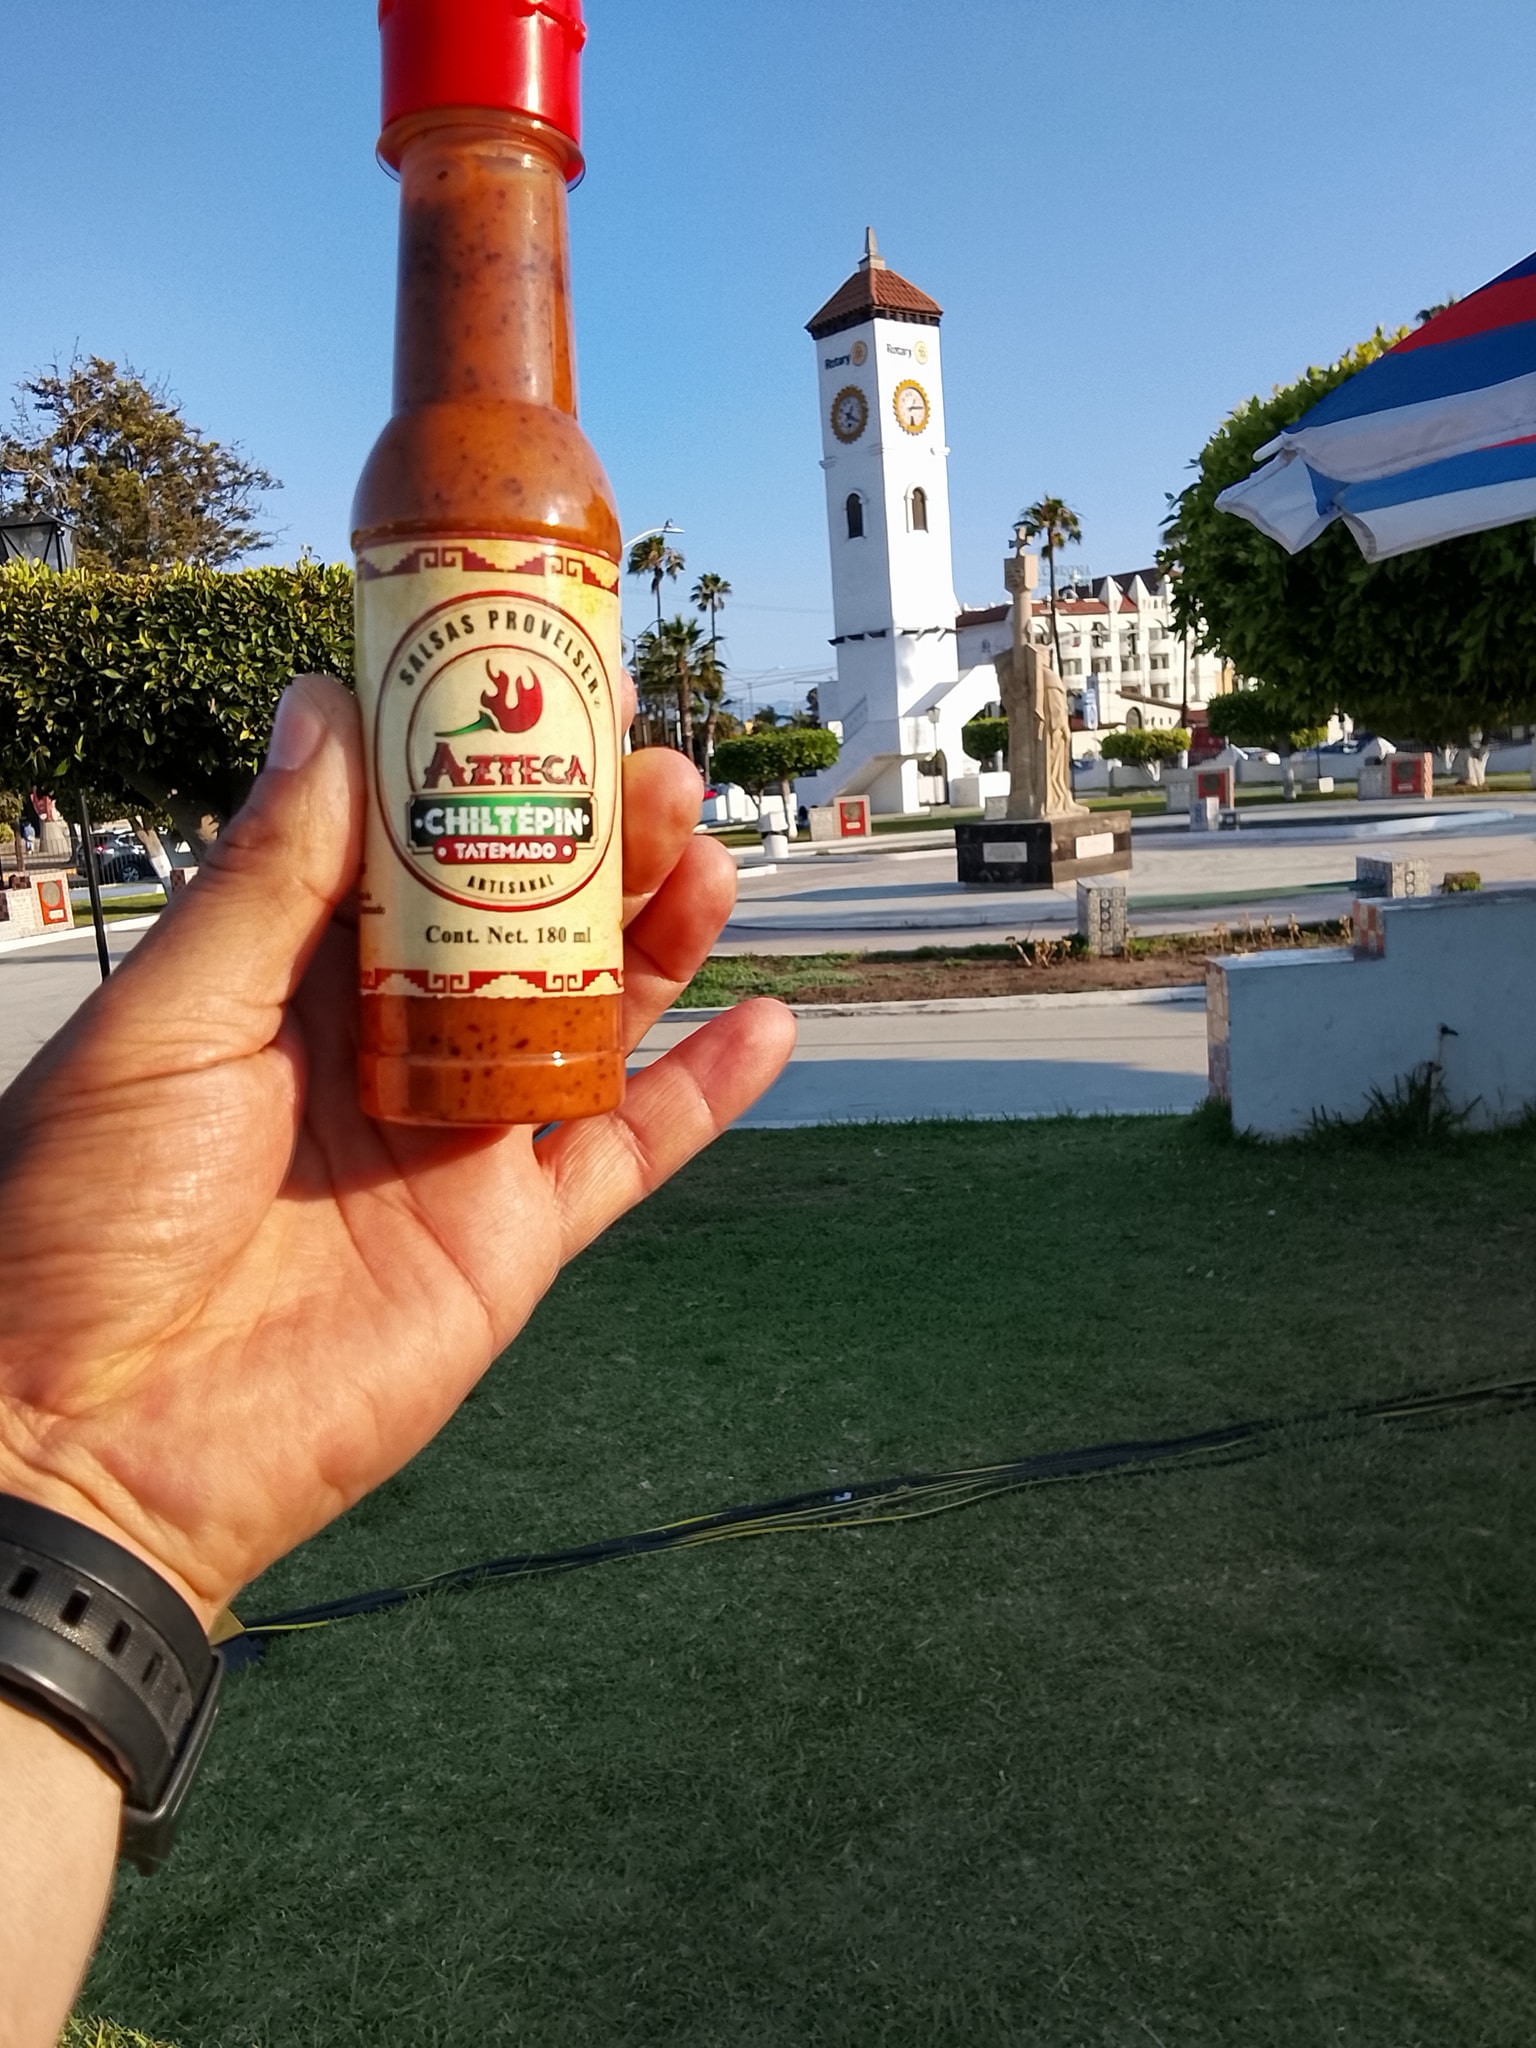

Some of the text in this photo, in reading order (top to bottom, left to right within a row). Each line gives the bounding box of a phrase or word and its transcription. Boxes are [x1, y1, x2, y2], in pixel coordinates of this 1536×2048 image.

[886, 343, 912, 358] Rotary
[825, 354, 851, 370] Rotary
[399, 609, 600, 695] SALSAS PROVELSER
[422, 741, 588, 789] AZTECA
[423, 802, 584, 836] CHILTÉPIN
[453, 842, 557, 860] TATEMADO
[466, 873, 555, 894] ARTESANAL
[425, 925, 592, 944] Cont. Net. 180 ml
